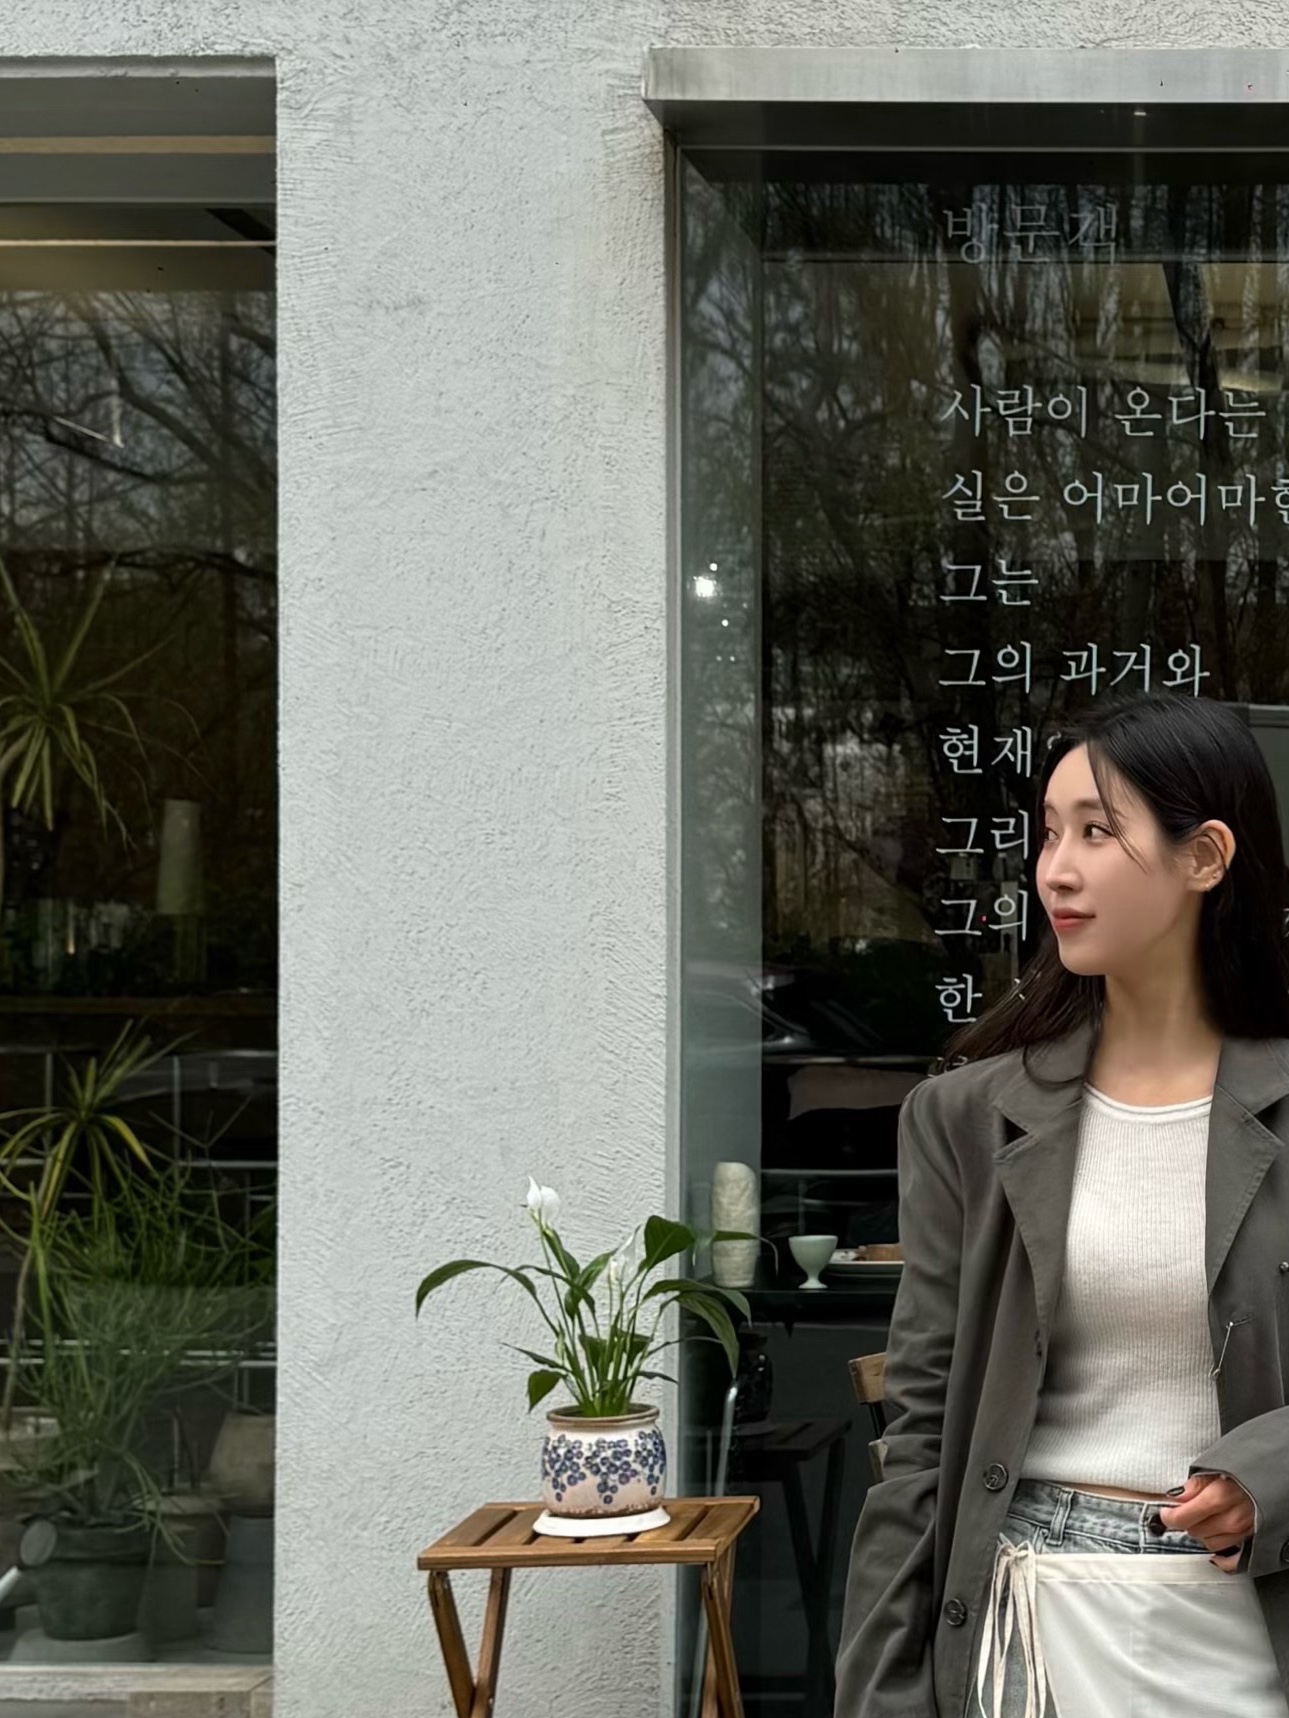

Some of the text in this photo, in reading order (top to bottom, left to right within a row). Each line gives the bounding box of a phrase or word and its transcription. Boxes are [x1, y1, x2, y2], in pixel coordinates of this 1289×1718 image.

[943, 203, 1118, 265] 방문객
[941, 383, 1088, 438] 사람이
[1114, 386, 1266, 438] 온다는
[941, 469, 1040, 522] 실은
[939, 558, 1039, 606] 그는
[938, 641, 1211, 698] 그의 과거와
[938, 723, 1062, 779] 현재
[936, 809, 1030, 861] 그리
[934, 889, 1029, 942] 그의
[934, 973, 983, 1023] 한
